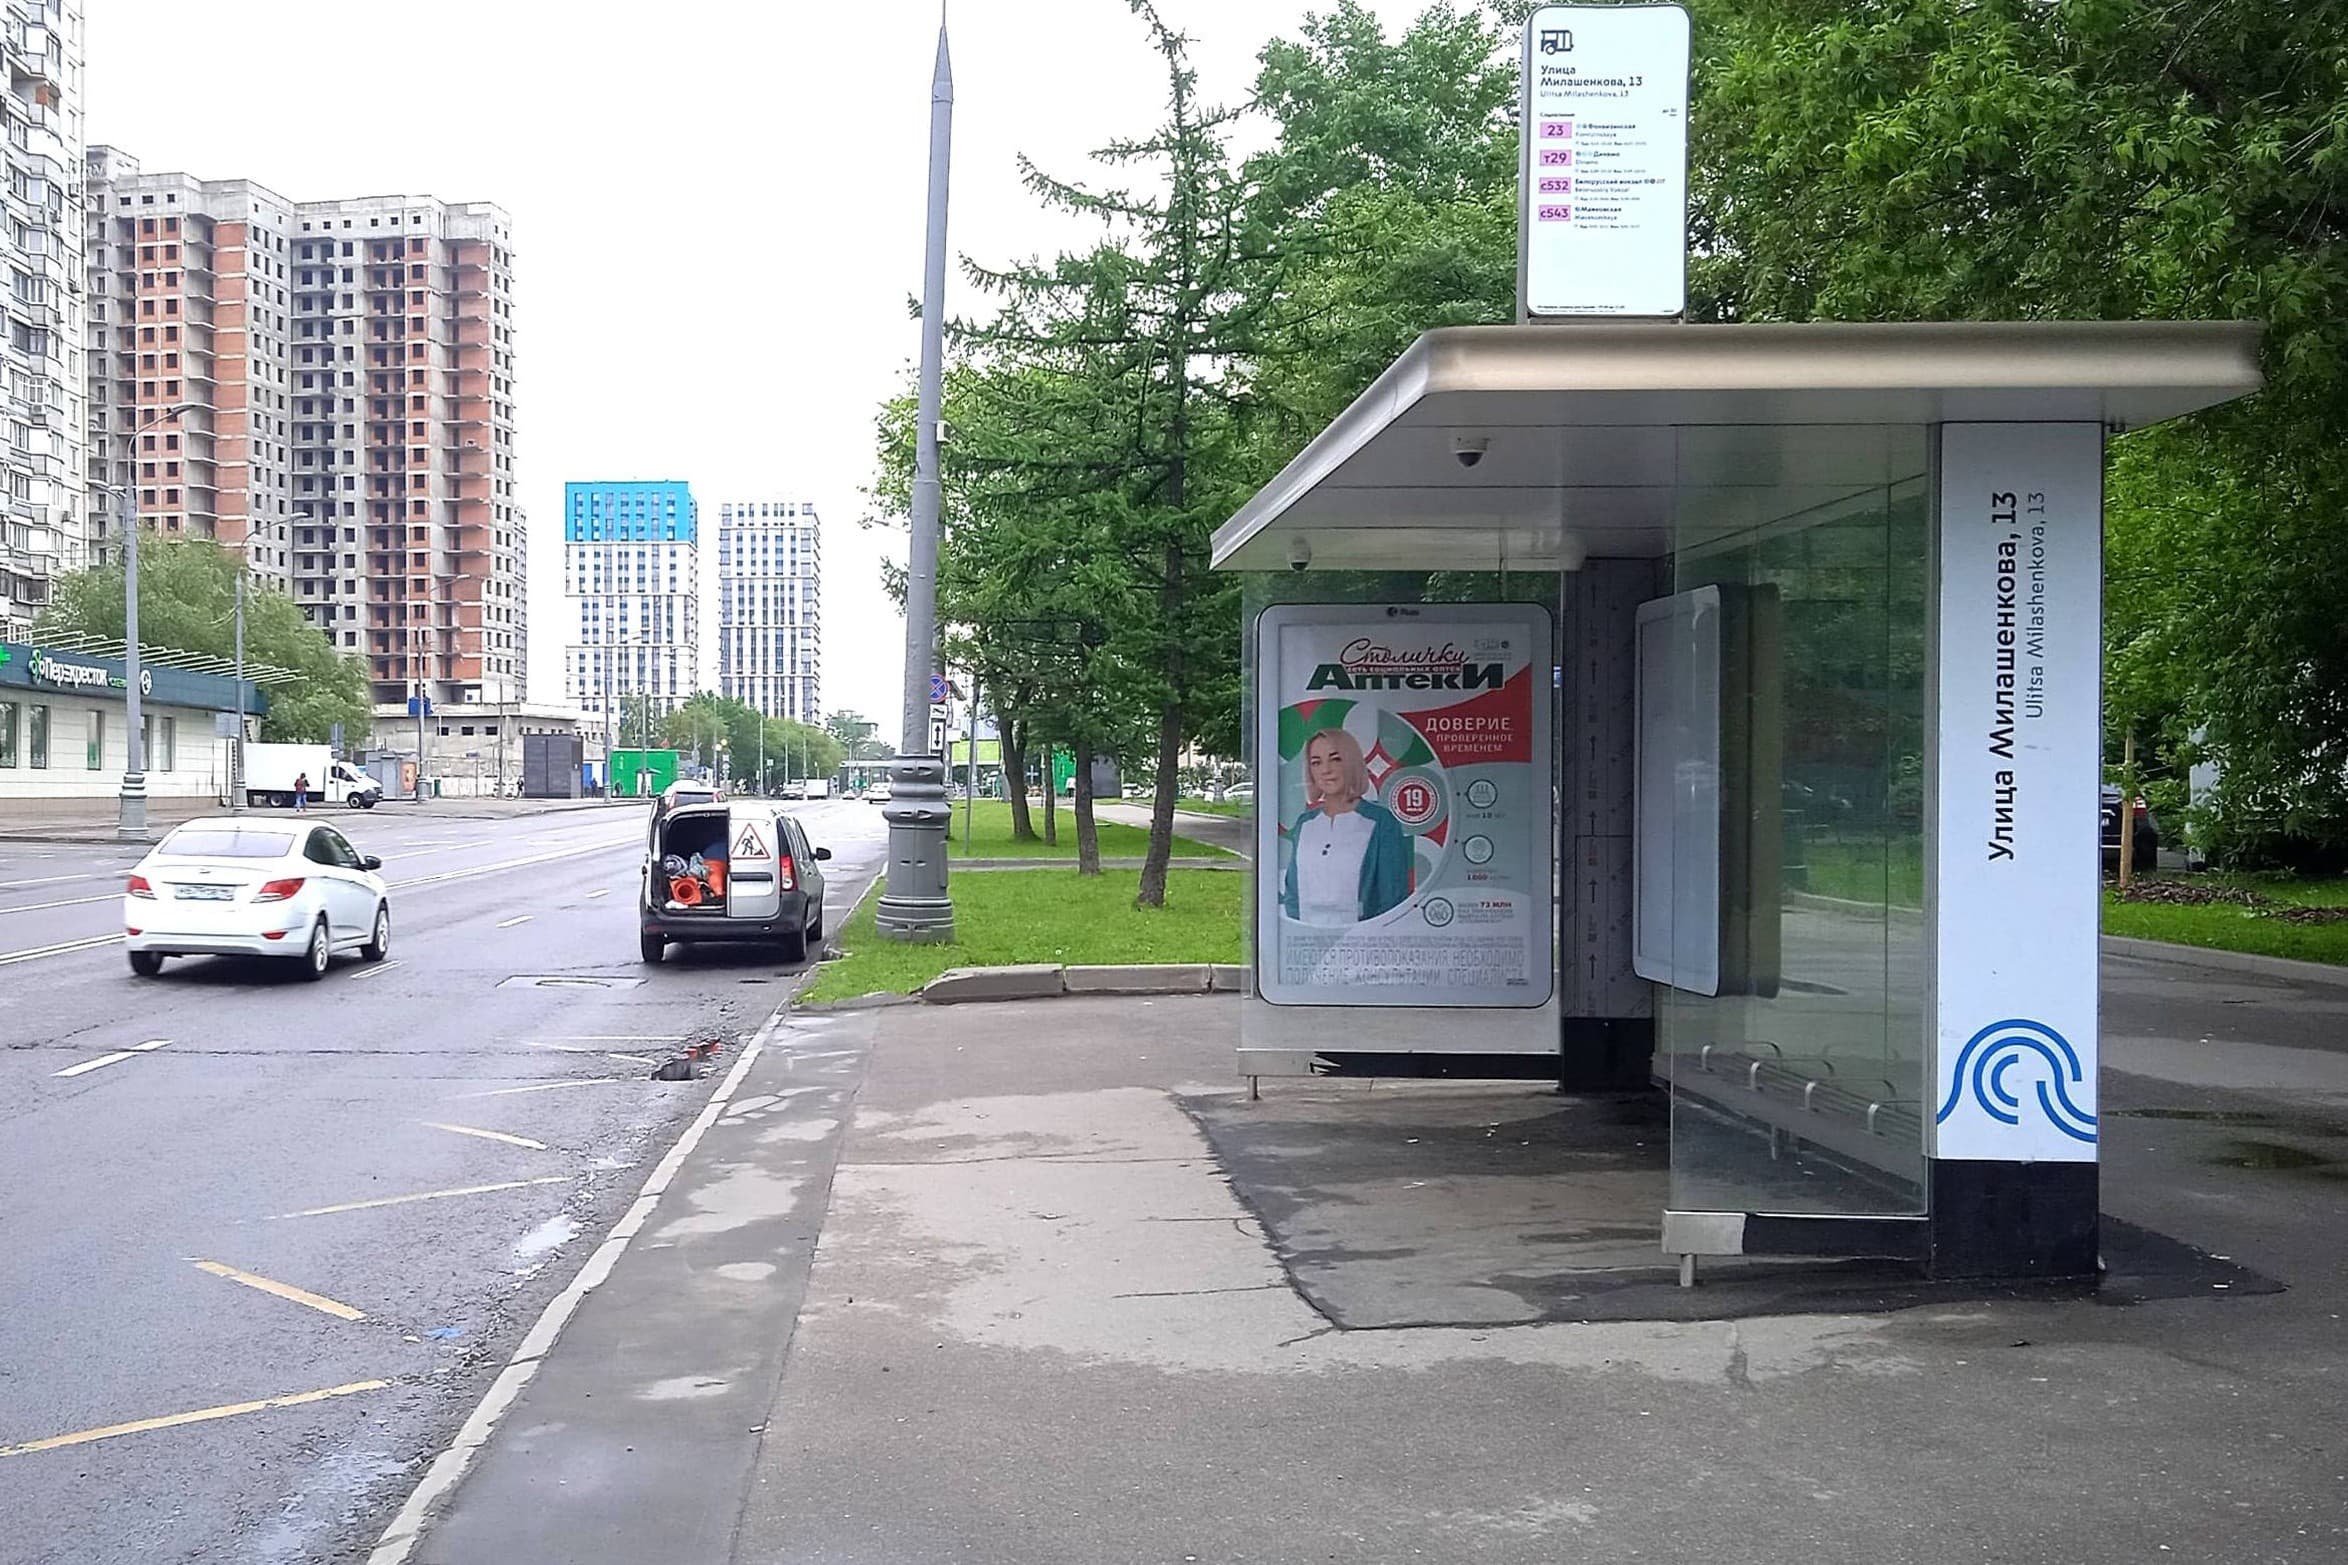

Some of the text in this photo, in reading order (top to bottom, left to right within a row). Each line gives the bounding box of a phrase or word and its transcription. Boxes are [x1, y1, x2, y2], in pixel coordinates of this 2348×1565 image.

[1541, 65, 1576, 76] Улица
[1541, 76, 1642, 87] Милашенкова, 13
[1547, 125, 1564, 136] 23
[2025, 491, 2047, 719] Ulitsa Milashenkova, 13
[1340, 638, 1470, 665] Столички
[1988, 491, 2022, 861] Улица Милашенкова, 13
[1443, 744, 1503, 753] ВРЕМЕНЕМ
[1403, 788, 1423, 807] 19
